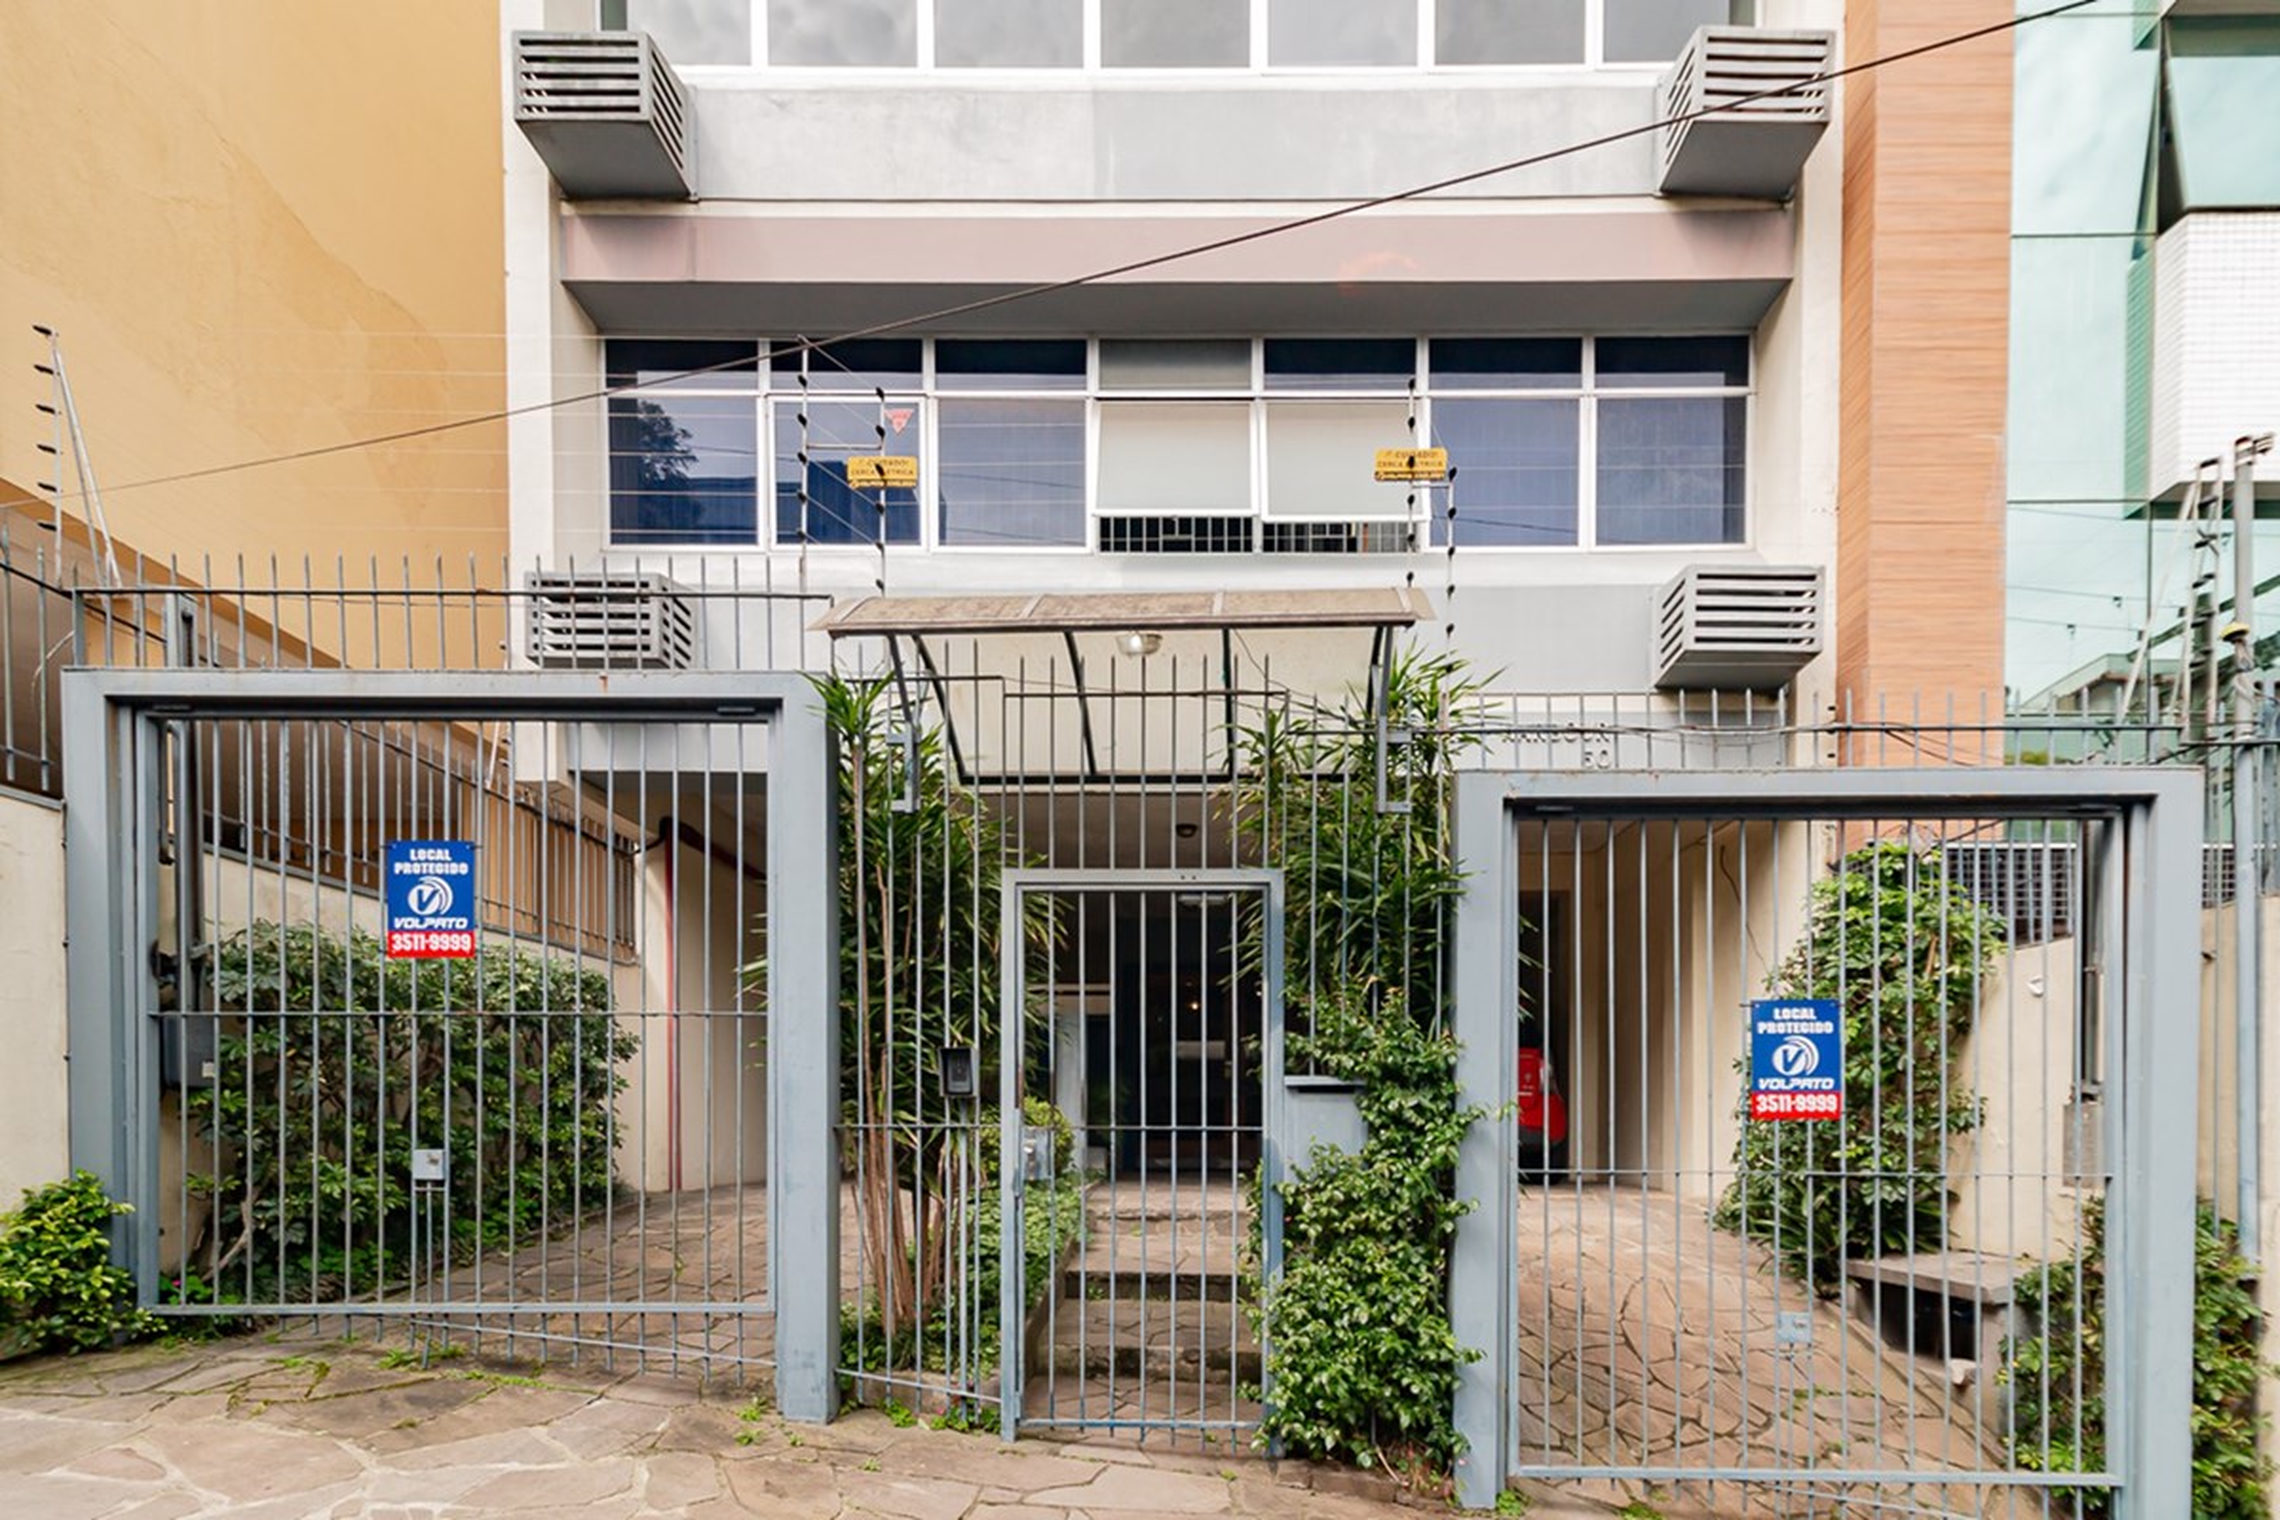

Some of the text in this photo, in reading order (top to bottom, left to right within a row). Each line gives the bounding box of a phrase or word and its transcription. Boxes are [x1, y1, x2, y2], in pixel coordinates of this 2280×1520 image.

[410, 848, 452, 861] LOCAL
[394, 862, 469, 875] PROTEGIDO
[394, 917, 469, 929] VOLPATO
[392, 933, 472, 952] 3511-9999
[1773, 1007, 1817, 1020] LOCAL
[1757, 1021, 1834, 1034] PROTEGIDO
[1758, 1078, 1835, 1090] VOLPATO
[1756, 1094, 1838, 1112] 3511-9999
